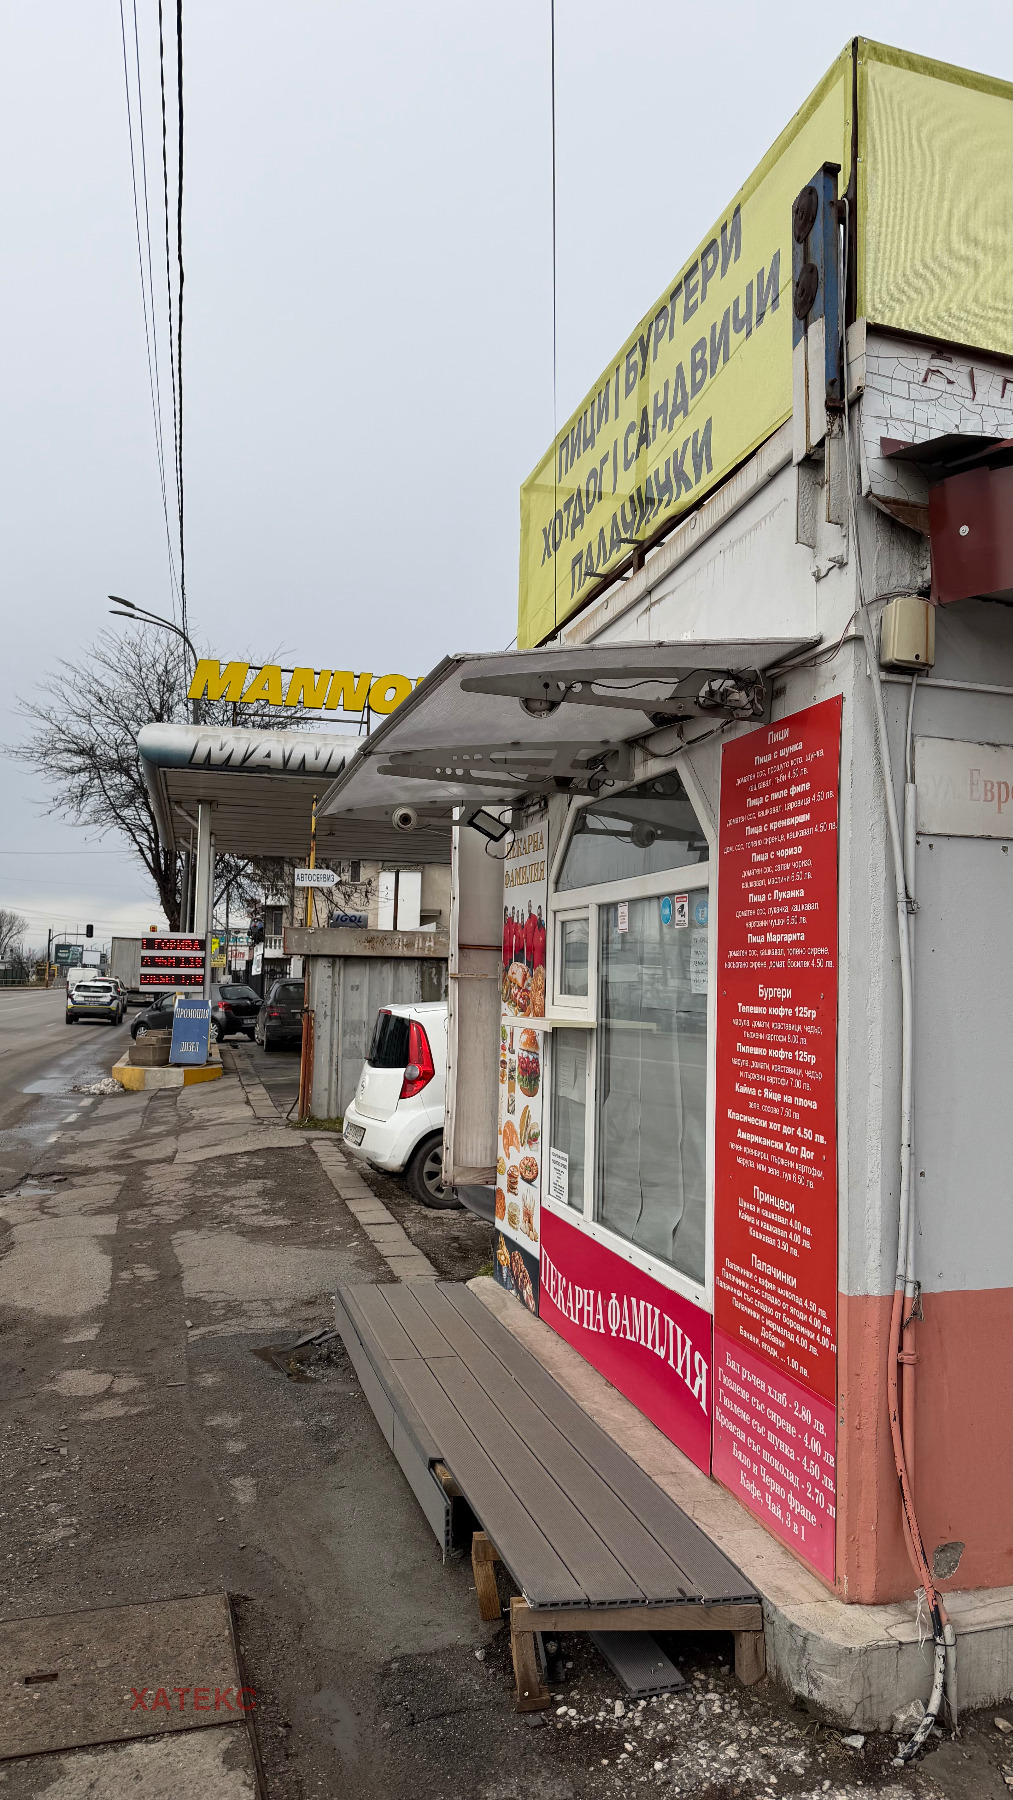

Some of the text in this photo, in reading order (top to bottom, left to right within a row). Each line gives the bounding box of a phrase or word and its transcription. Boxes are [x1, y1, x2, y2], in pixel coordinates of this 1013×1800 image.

[558, 378, 610, 484] ПИЦИ
[624, 202, 742, 400] БУРГЕРИ
[541, 449, 610, 567] ХОТДОГ
[622, 248, 781, 471] САНДВИЧИ
[570, 416, 714, 600] ПАЛАЧИНКИ
[188, 659, 425, 715] MANNO
[768, 728, 789, 744] Пици
[754, 753, 771, 765] Пица
[779, 742, 802, 757] шунка
[746, 797, 763, 807] Пица
[770, 789, 788, 800] пиле
[790, 782, 810, 796] филе
[969, 768, 1013, 814] Евр
[745, 825, 762, 835] Пица
[769, 813, 810, 831] кренвирши
[506, 830, 544, 860] ПЕКАРНА
[751, 853, 768, 862] Пица
[776, 846, 802, 858] чоризо
[296, 874, 334, 883] АВТОСЕРВИЗ
[504, 860, 545, 888] ФАМИЛИЯ
[748, 893, 765, 903] Пица
[773, 889, 804, 901] Луканка
[336, 914, 362, 924] IGOL
[747, 932, 804, 944] Пица Маргарита
[758, 984, 791, 1001] Бургери
[176, 1008, 210, 1019] ПРОМОЦИЯ
[738, 1003, 816, 1020] Телешко кюфте 125гр
[180, 1042, 200, 1052] ДИЗЕЛ
[736, 1043, 816, 1065] Пилешко кюфте 125гр
[735, 1082, 817, 1109] Кайма с Яйце на плоча
[727, 1109, 826, 1144] Класически хот дог 4.50 лв.
[737, 1129, 814, 1159] Американски Хот Дог
[753, 1186, 794, 1213] Принцеси
[738, 1197, 755, 1212] Шунка
[761, 1209, 788, 1225] кашкавал
[789, 1218, 801, 1231] 4.00
[802, 1226, 812, 1236] лв.
[738, 1209, 754, 1224] Кайма
[760, 1221, 787, 1238] кашкавал
[788, 1232, 800, 1244] 4.00
[802, 1239, 811, 1249] лв.
[749, 1227, 799, 1257] Кашкавал 3.50 лв.
[751, 1254, 796, 1287] Палачинки
[722, 1268, 832, 1336] Палачинки със сладко от ягоди 4.00 лв.
[725, 1258, 752, 1278] Палачинки
[753, 1274, 757, 1282] с
[804, 1299, 816, 1312] 4.50
[818, 1308, 827, 1319] лв.
[716, 1276, 836, 1353] Палачинки със сладко от боровинки 4.00 л
[732, 1297, 760, 1320] Палачинки
[766, 1319, 794, 1343] мармалад
[795, 1335, 807, 1349] 4.00
[808, 1345, 818, 1356] лв.
[540, 1244, 708, 1416] ПЕКАРНА ФАМИЛИЯ
[760, 1327, 785, 1348] Добавки
[787, 1356, 798, 1370] 1.00
[799, 1366, 809, 1378] лв.
[726, 1352, 740, 1374] Бял
[741, 1367, 765, 1392] ръчен
[767, 1386, 787, 1407] хляб
[794, 1401, 811, 1424] 2.80
[718, 1367, 749, 1402] Гюзлеме
[751, 1396, 765, 1413] със
[766, 1408, 796, 1437] сирене
[804, 1433, 821, 1456] 4.00
[719, 1388, 750, 1424] Гюзлеме
[751, 1419, 765, 1436] със
[767, 1431, 794, 1460] шунка
[802, 1456, 820, 1479] 4.50
[716, 1406, 745, 1442] Кроасан
[747, 1437, 760, 1455] със
[762, 1449, 799, 1490] шоколад
[806, 1482, 824, 1508] 2.70
[826, 1503, 835, 1518] л
[732, 1441, 816, 1526] Бяло и Черно фрапе
[765, 1492, 783, 1523] Чай,
[785, 1512, 791, 1527] 3
[793, 1522, 798, 1534] в
[801, 1526, 805, 1541] 1
